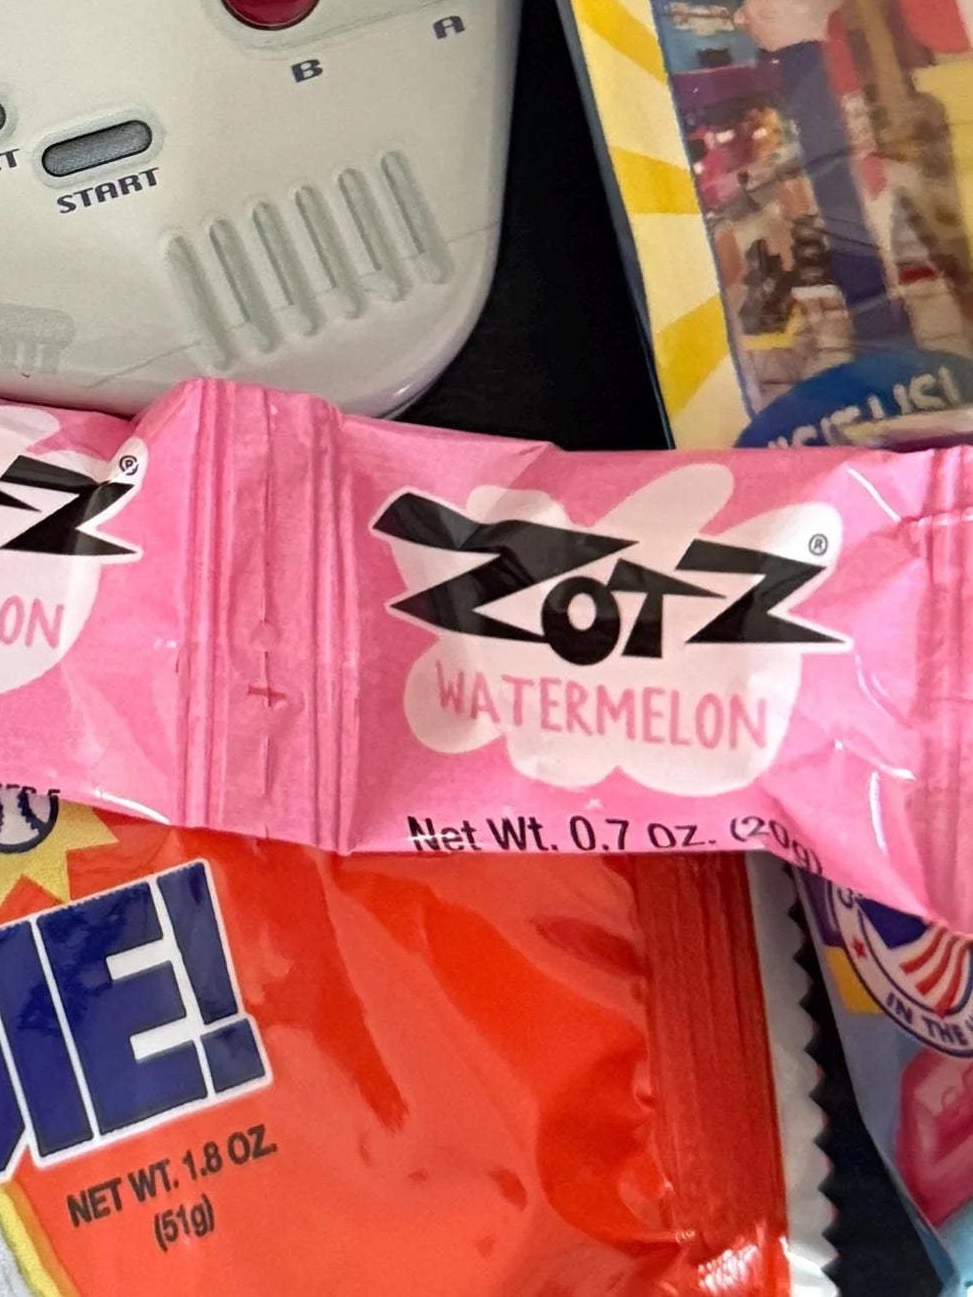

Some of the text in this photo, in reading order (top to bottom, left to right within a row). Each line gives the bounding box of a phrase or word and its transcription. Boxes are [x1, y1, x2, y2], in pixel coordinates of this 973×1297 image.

[433, 14, 465, 40] A
[290, 58, 323, 83] B
[56, 167, 163, 214] START
[371, 491, 848, 667] ZOTZ
[435, 659, 767, 750] WATERMELON
[407, 815, 482, 851] Net
[486, 816, 559, 851] Wt.
[569, 814, 629, 851] 0.7
[885, 991, 914, 1025] IN
[921, 1013, 970, 1047] THE
[66, 1123, 278, 1229] NET WT. 1.8 OZ.
[153, 1192, 216, 1254] (51g)
